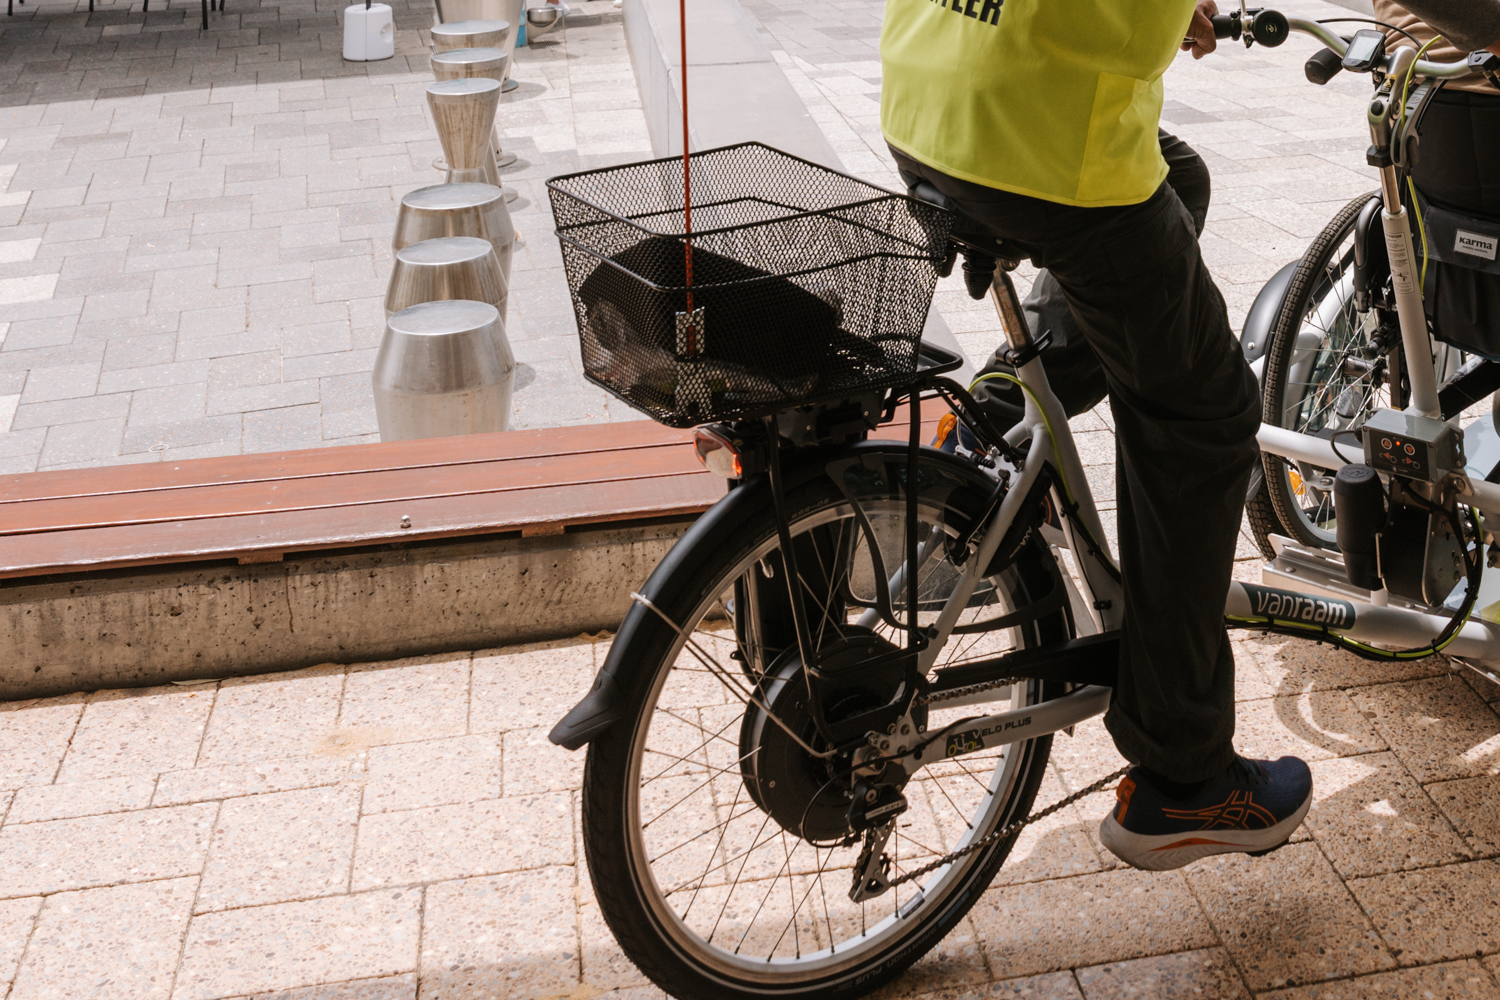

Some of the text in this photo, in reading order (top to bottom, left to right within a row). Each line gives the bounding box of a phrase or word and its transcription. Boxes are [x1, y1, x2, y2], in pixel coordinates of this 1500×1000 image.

[1256, 590, 1348, 626] vanraam
[972, 716, 1032, 739] VELO PLUS
